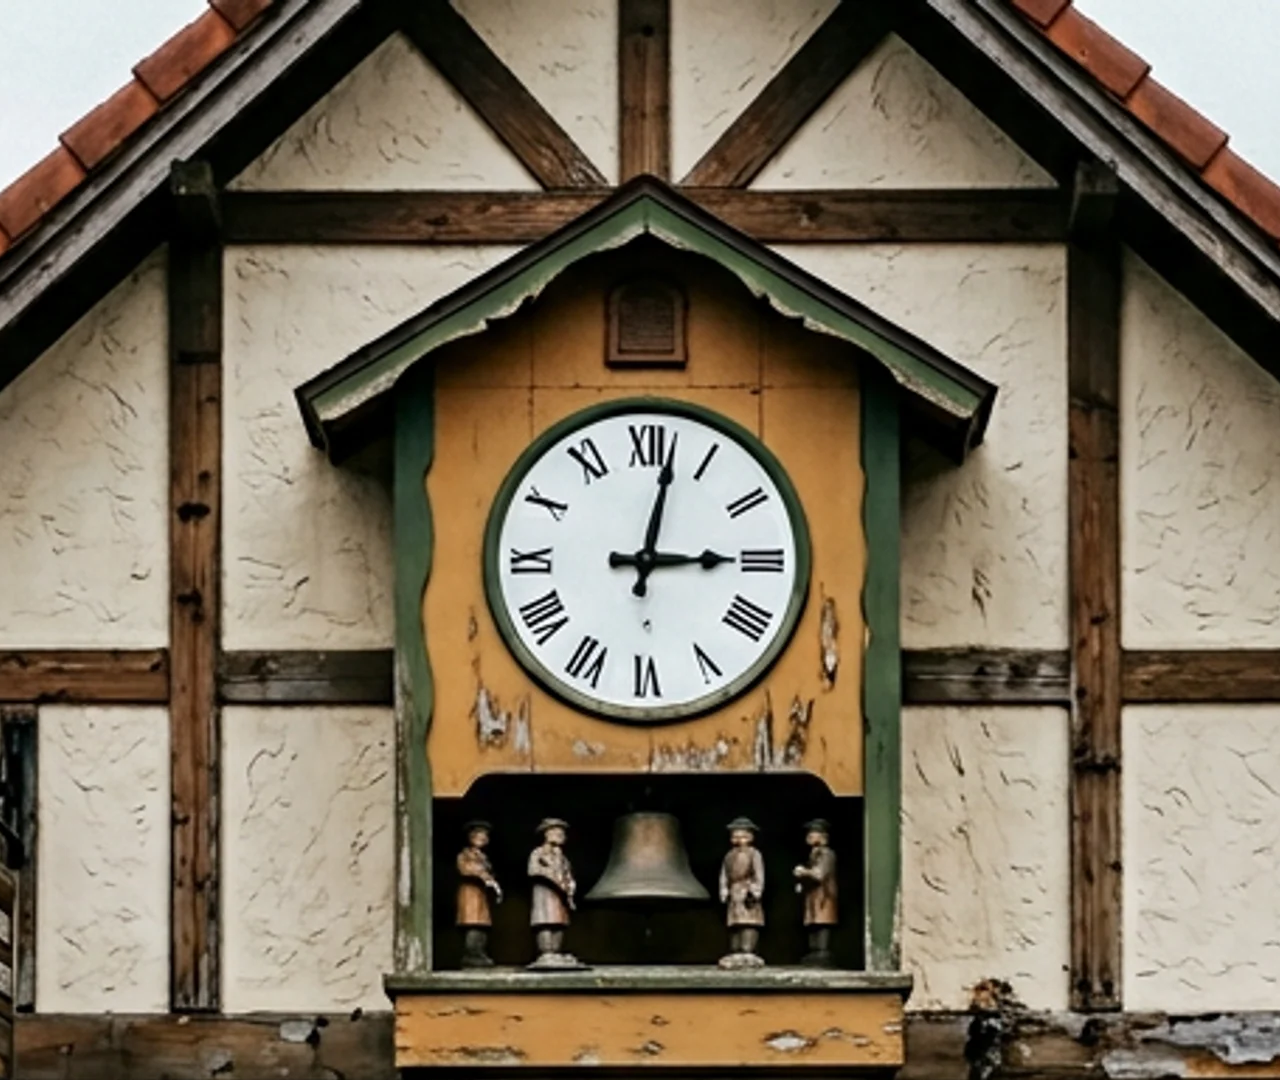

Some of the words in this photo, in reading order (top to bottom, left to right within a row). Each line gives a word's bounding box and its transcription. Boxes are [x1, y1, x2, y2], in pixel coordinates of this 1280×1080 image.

[567, 438, 609, 484] XI
[629, 425, 665, 467] XII
[693, 444, 719, 481] I
[525, 486, 568, 522] X
[726, 487, 768, 519] II
[741, 549, 784, 572] III
[519, 589, 569, 646] VIII
[722, 595, 773, 642] IIII
[564, 636, 607, 689] VII
[634, 655, 661, 698] VI
[693, 643, 723, 684] V
